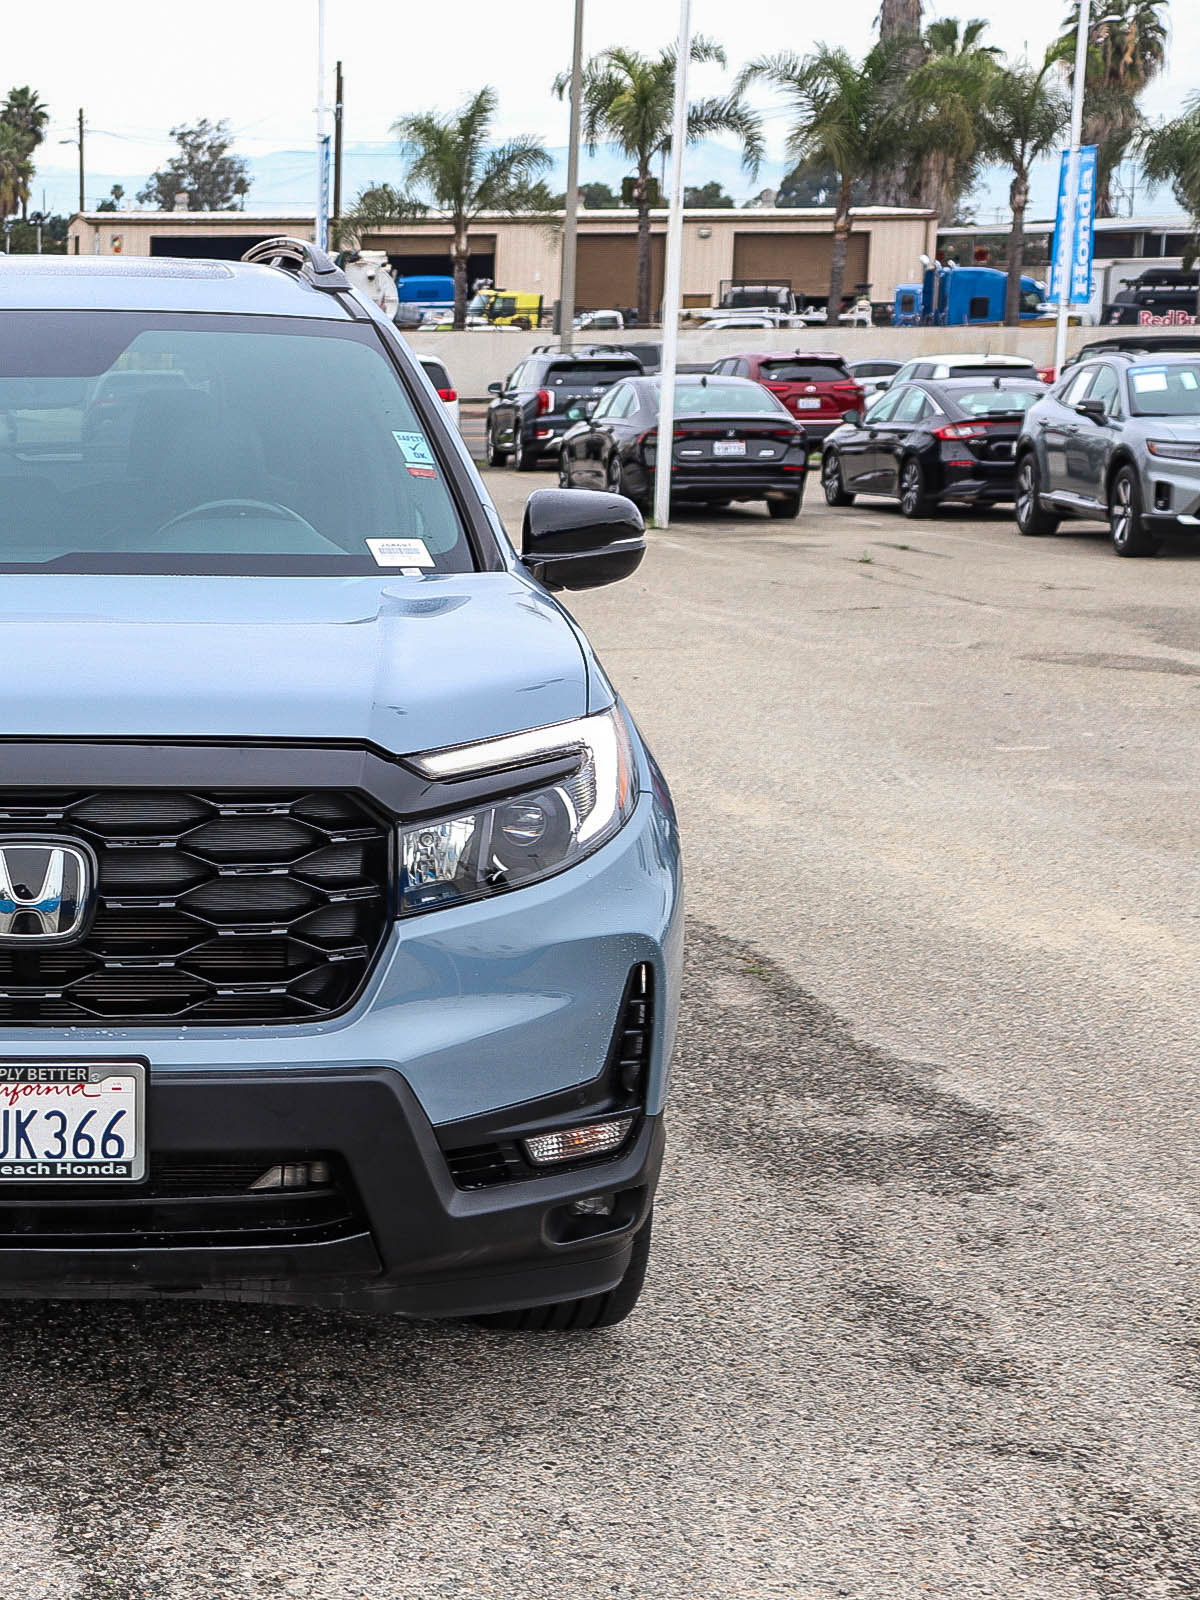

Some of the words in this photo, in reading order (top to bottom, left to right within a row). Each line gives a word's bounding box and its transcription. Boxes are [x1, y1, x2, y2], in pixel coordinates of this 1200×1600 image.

[1073, 167, 1093, 295] Honda
[1138, 310, 1175, 326] Red
[396, 434, 425, 442] SAFETY
[27, 1068, 87, 1080] BETTER
[56, 1162, 127, 1175] Honda
